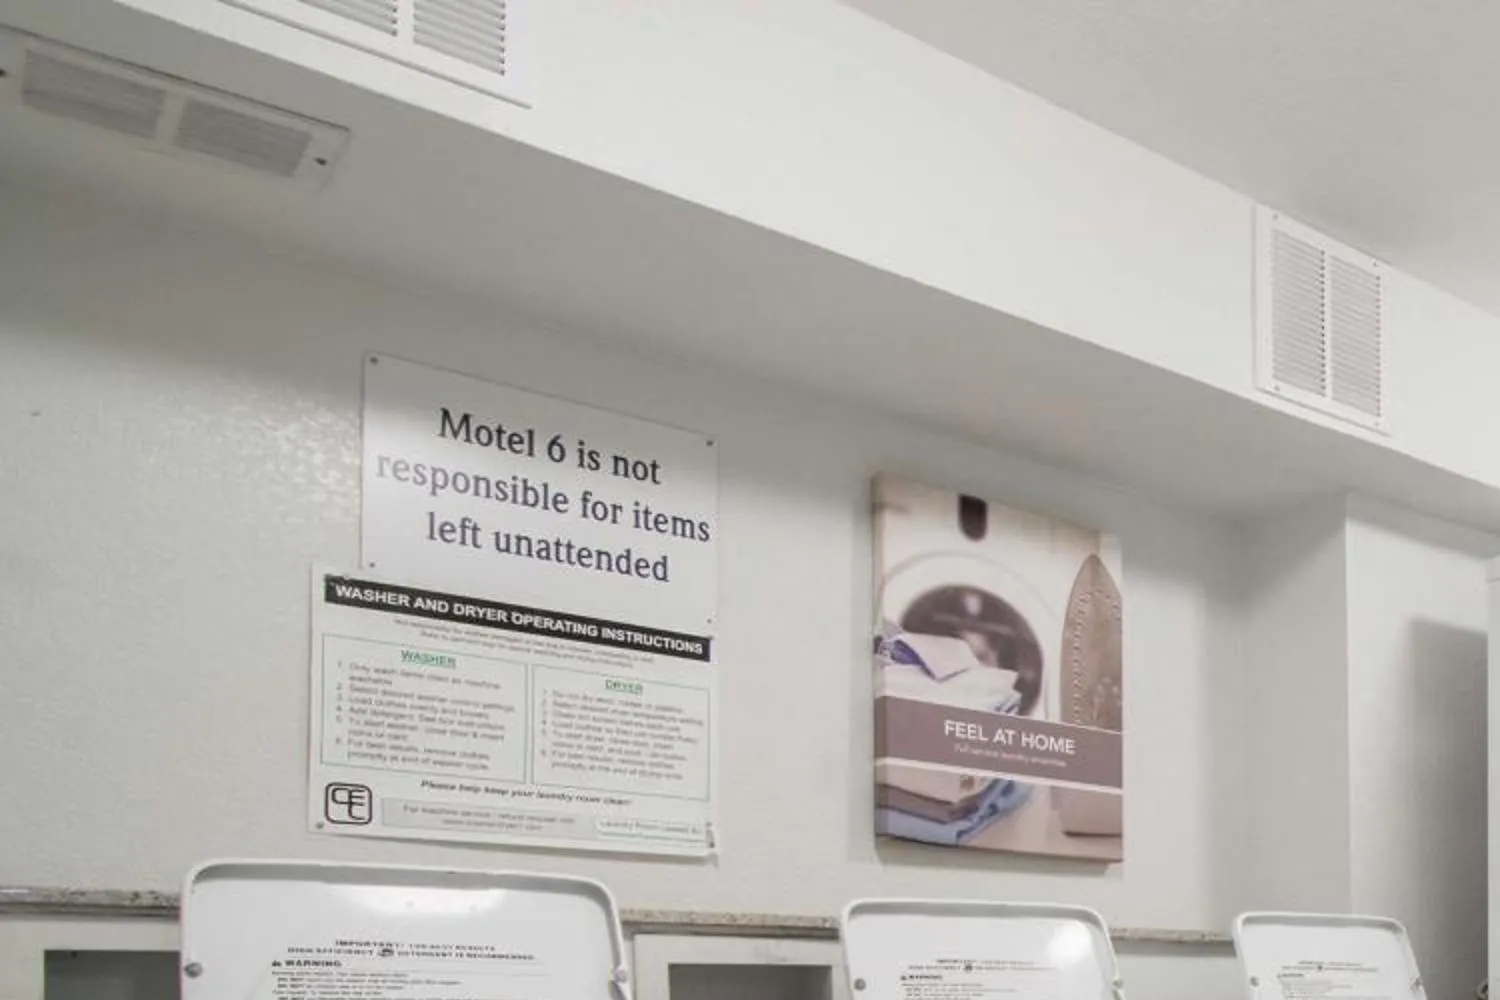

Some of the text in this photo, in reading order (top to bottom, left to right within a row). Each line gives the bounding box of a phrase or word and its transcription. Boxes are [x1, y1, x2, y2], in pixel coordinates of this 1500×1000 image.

[438, 407, 662, 484] Motel 6 is not
[375, 453, 710, 543] responsible for items
[426, 512, 670, 583] left unattended
[334, 584, 411, 608] WASHER
[414, 596, 449, 614] AND
[454, 602, 508, 623] DRYER
[511, 611, 598, 637] OPERATING
[601, 626, 704, 654] INSTRUCTIONS
[401, 649, 456, 668] WASHER
[605, 679, 643, 694] DRYER
[944, 719, 1077, 755] FEEL AT HOME
[510, 787, 534, 797] your
[535, 789, 573, 801] laundry
